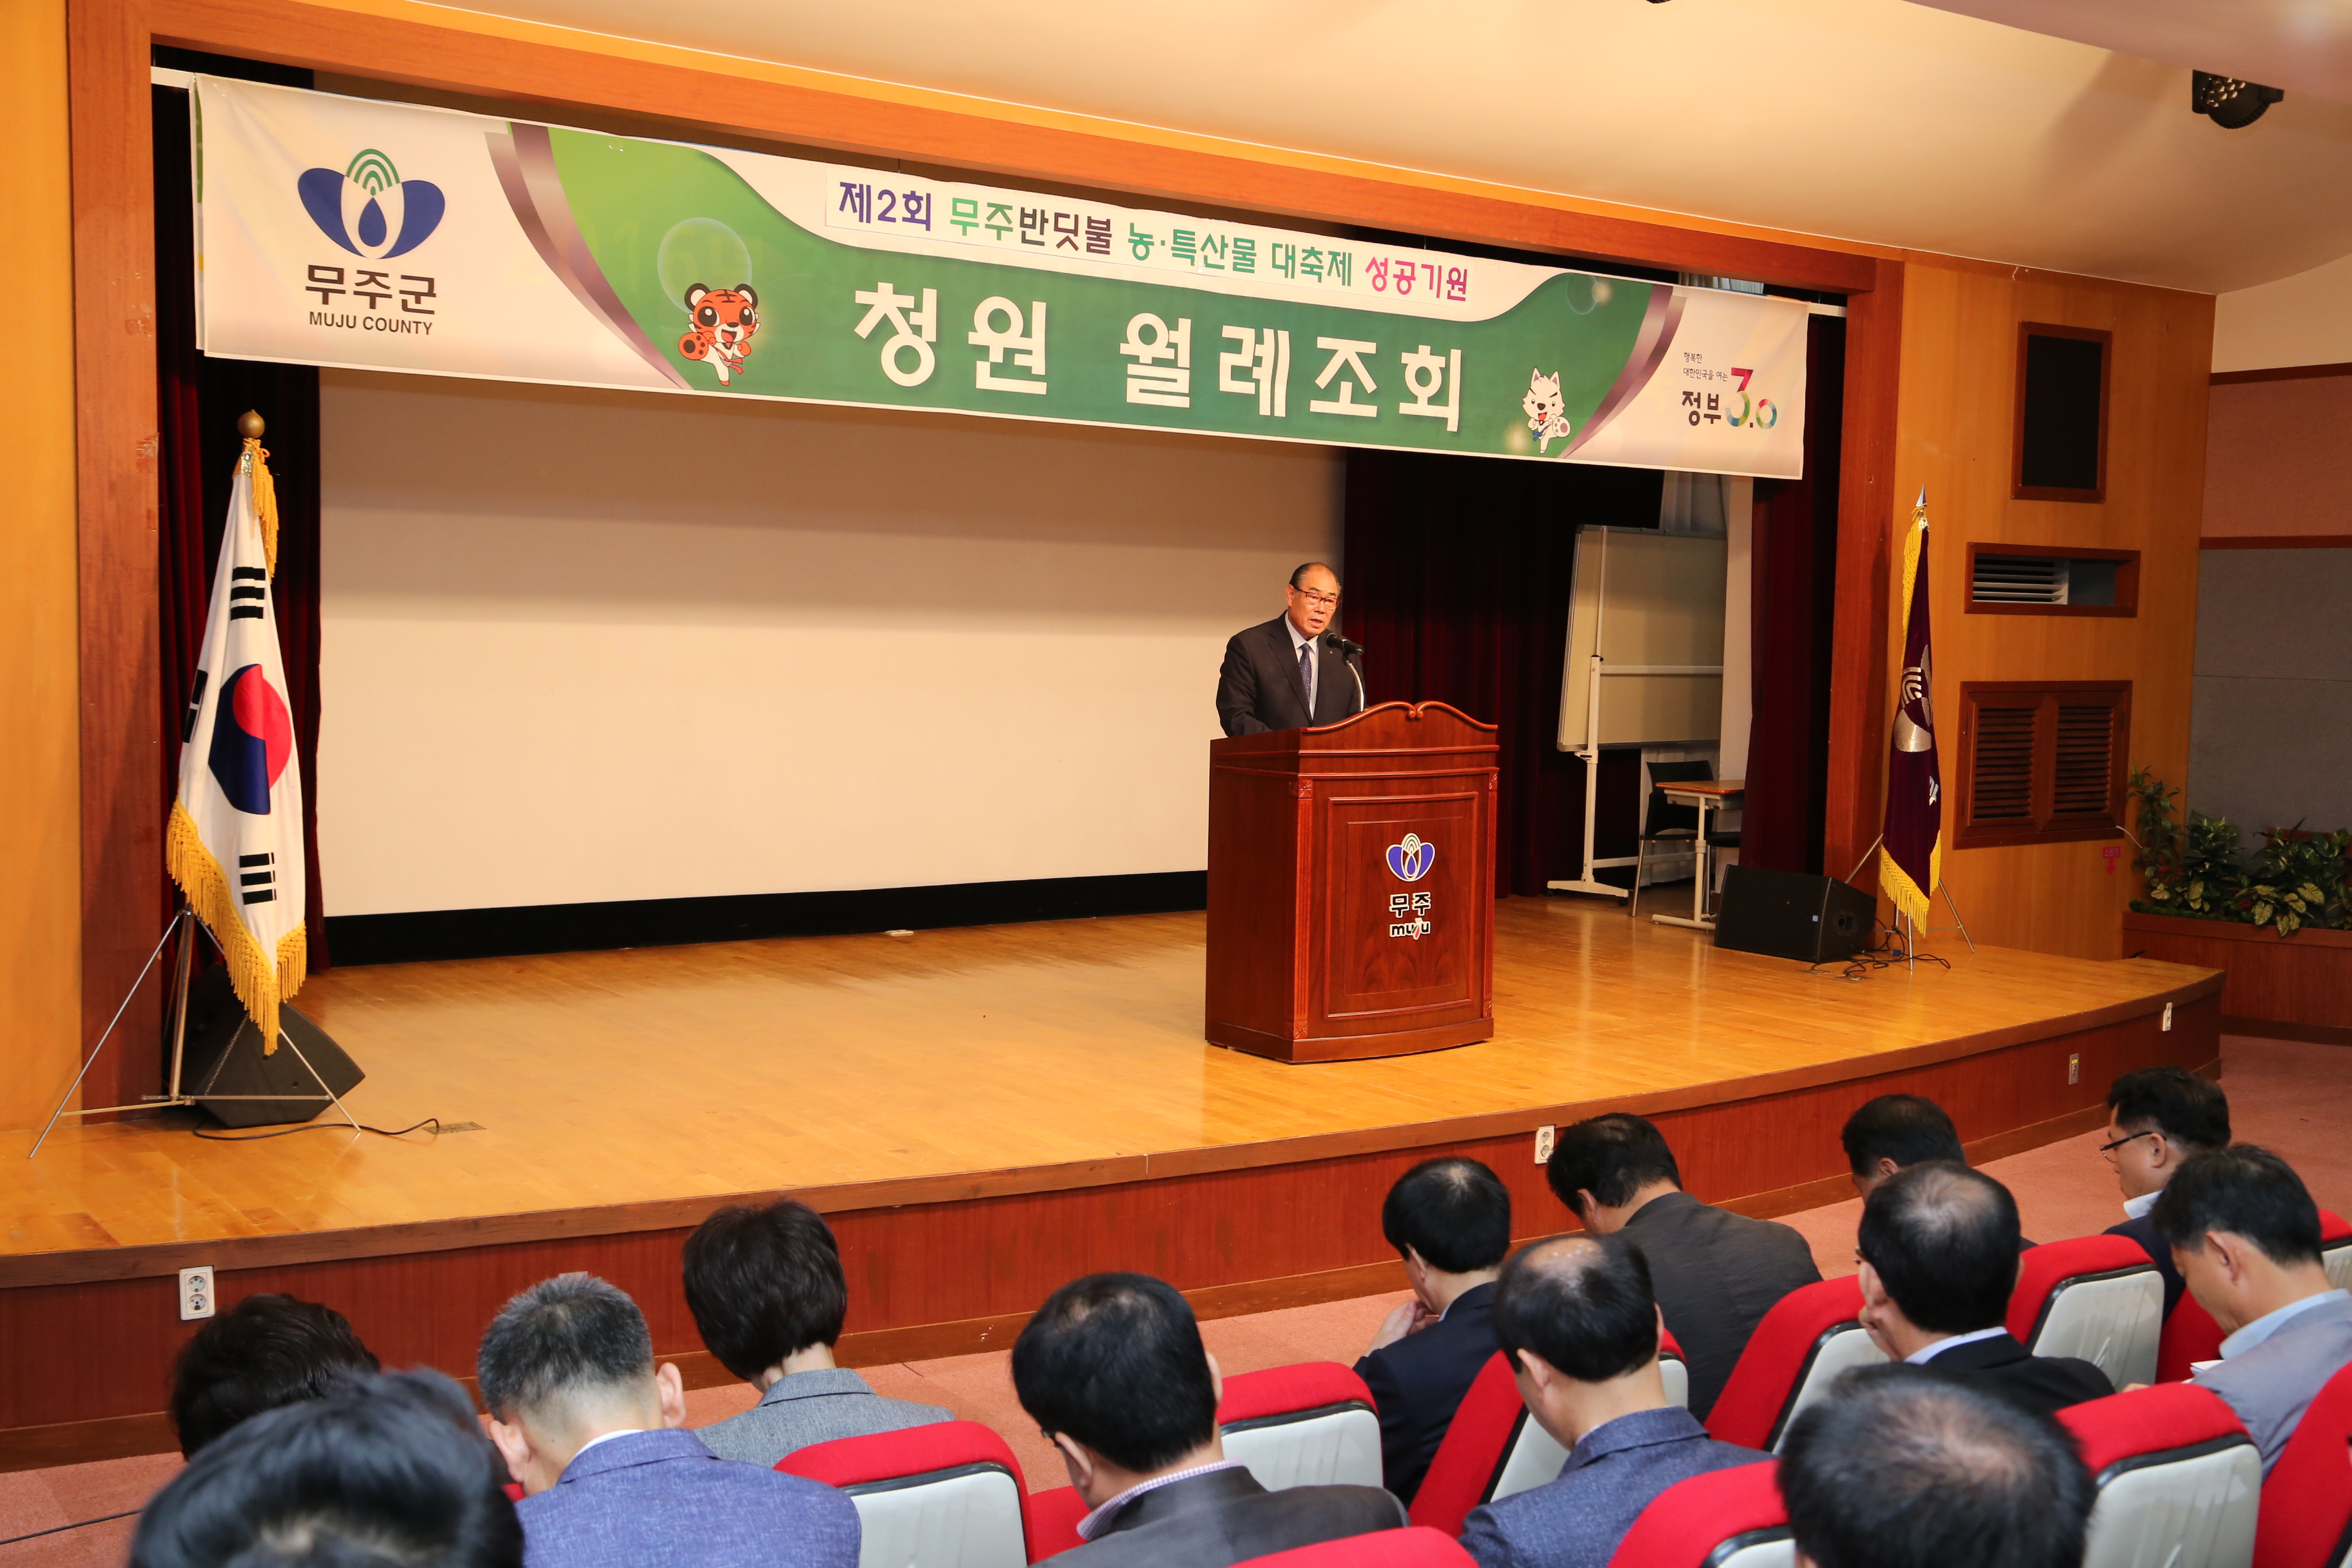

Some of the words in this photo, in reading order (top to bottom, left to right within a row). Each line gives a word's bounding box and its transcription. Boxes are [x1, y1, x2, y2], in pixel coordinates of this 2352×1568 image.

[839, 181, 931, 231] 제2회
[950, 197, 1112, 255] 무주반딧불
[1271, 243, 1353, 286] 대축제
[1365, 256, 1468, 302] 성공기원
[306, 265, 436, 315] 무주군
[309, 311, 357, 329] MUJU
[362, 317, 433, 335] COUNTY
[853, 281, 1048, 395] 청원
[1119, 312, 1462, 433] 월례조회
[1683, 352, 1703, 364] 행복한
[1683, 368, 1714, 380] 대한민국을
[1716, 371, 1729, 382] 여는
[1681, 391, 1721, 426] 정부
[1725, 367, 1777, 429] 3.0
[1389, 892, 1431, 918] 무주
